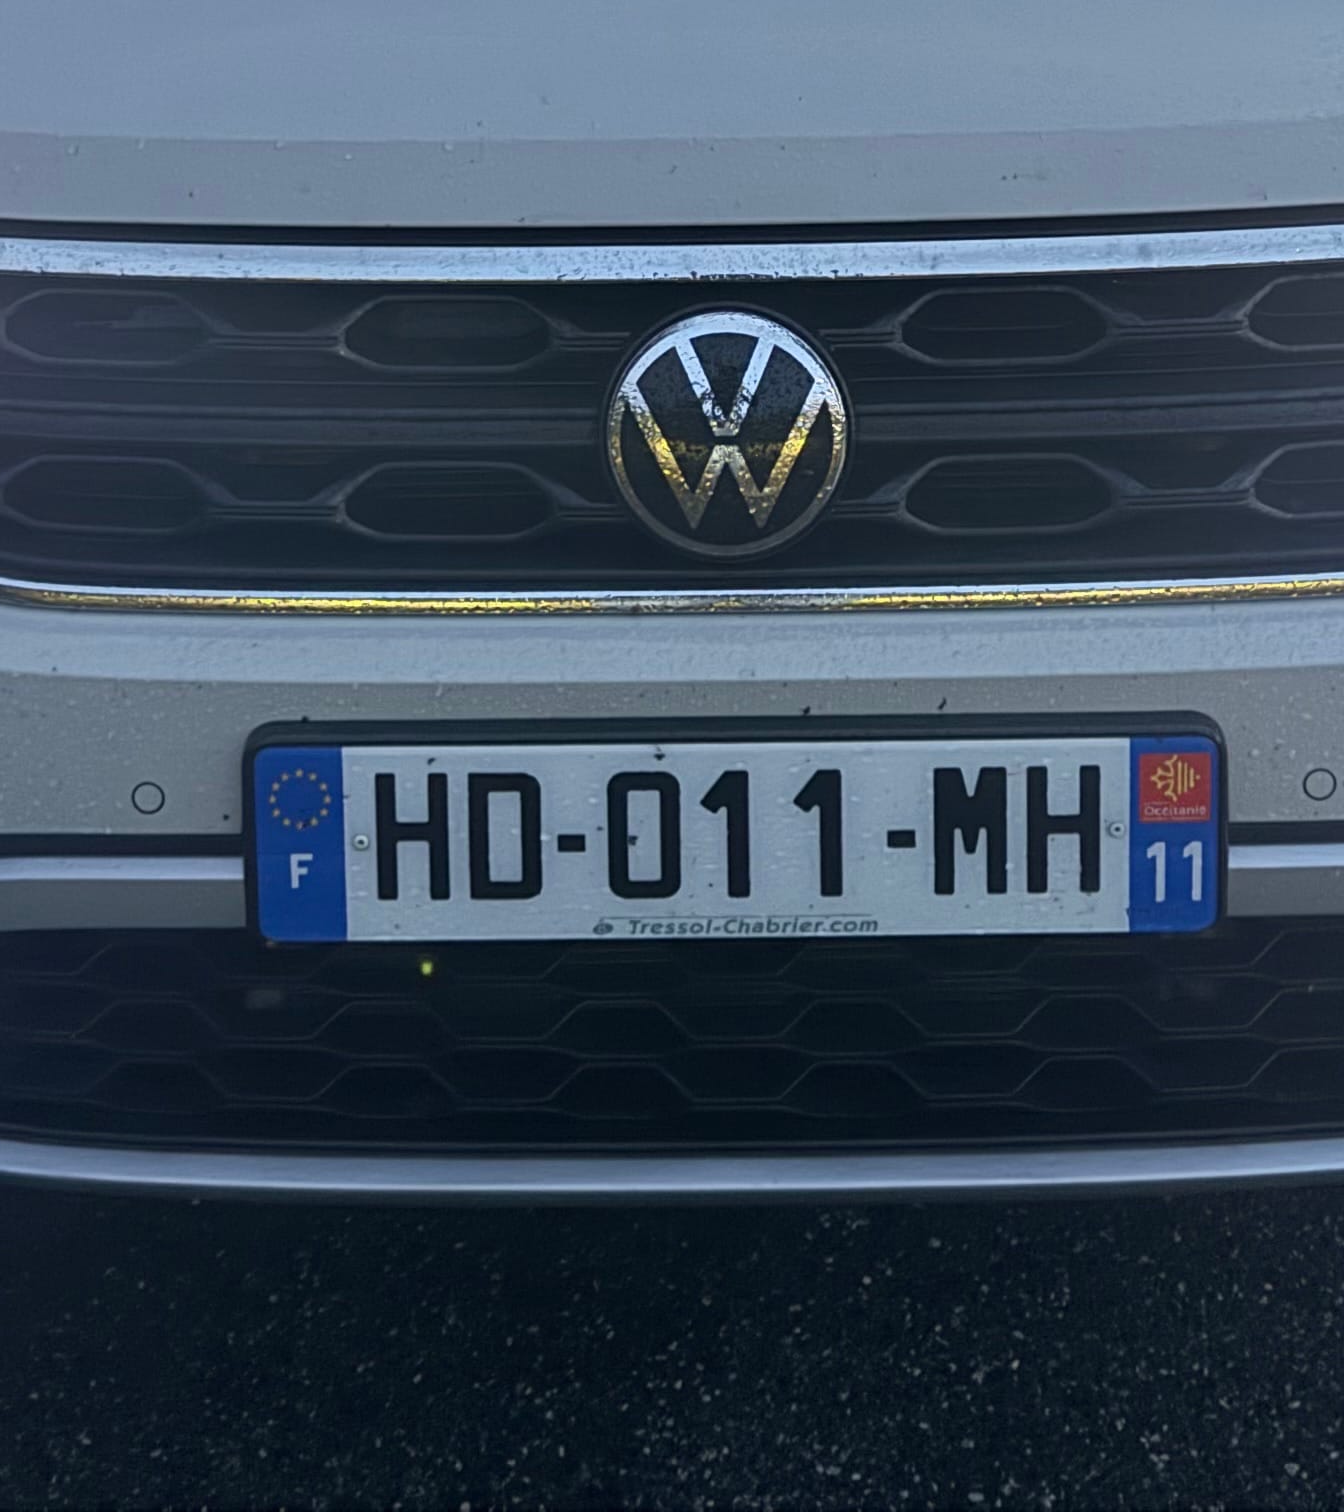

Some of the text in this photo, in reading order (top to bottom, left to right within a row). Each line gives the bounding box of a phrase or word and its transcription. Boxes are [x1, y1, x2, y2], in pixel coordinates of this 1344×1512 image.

[374, 764, 1101, 902] HD-011-MH
[289, 852, 314, 889] F
[1146, 840, 1203, 903] 11
[629, 918, 880, 936] Tressol-Chabrier.com
